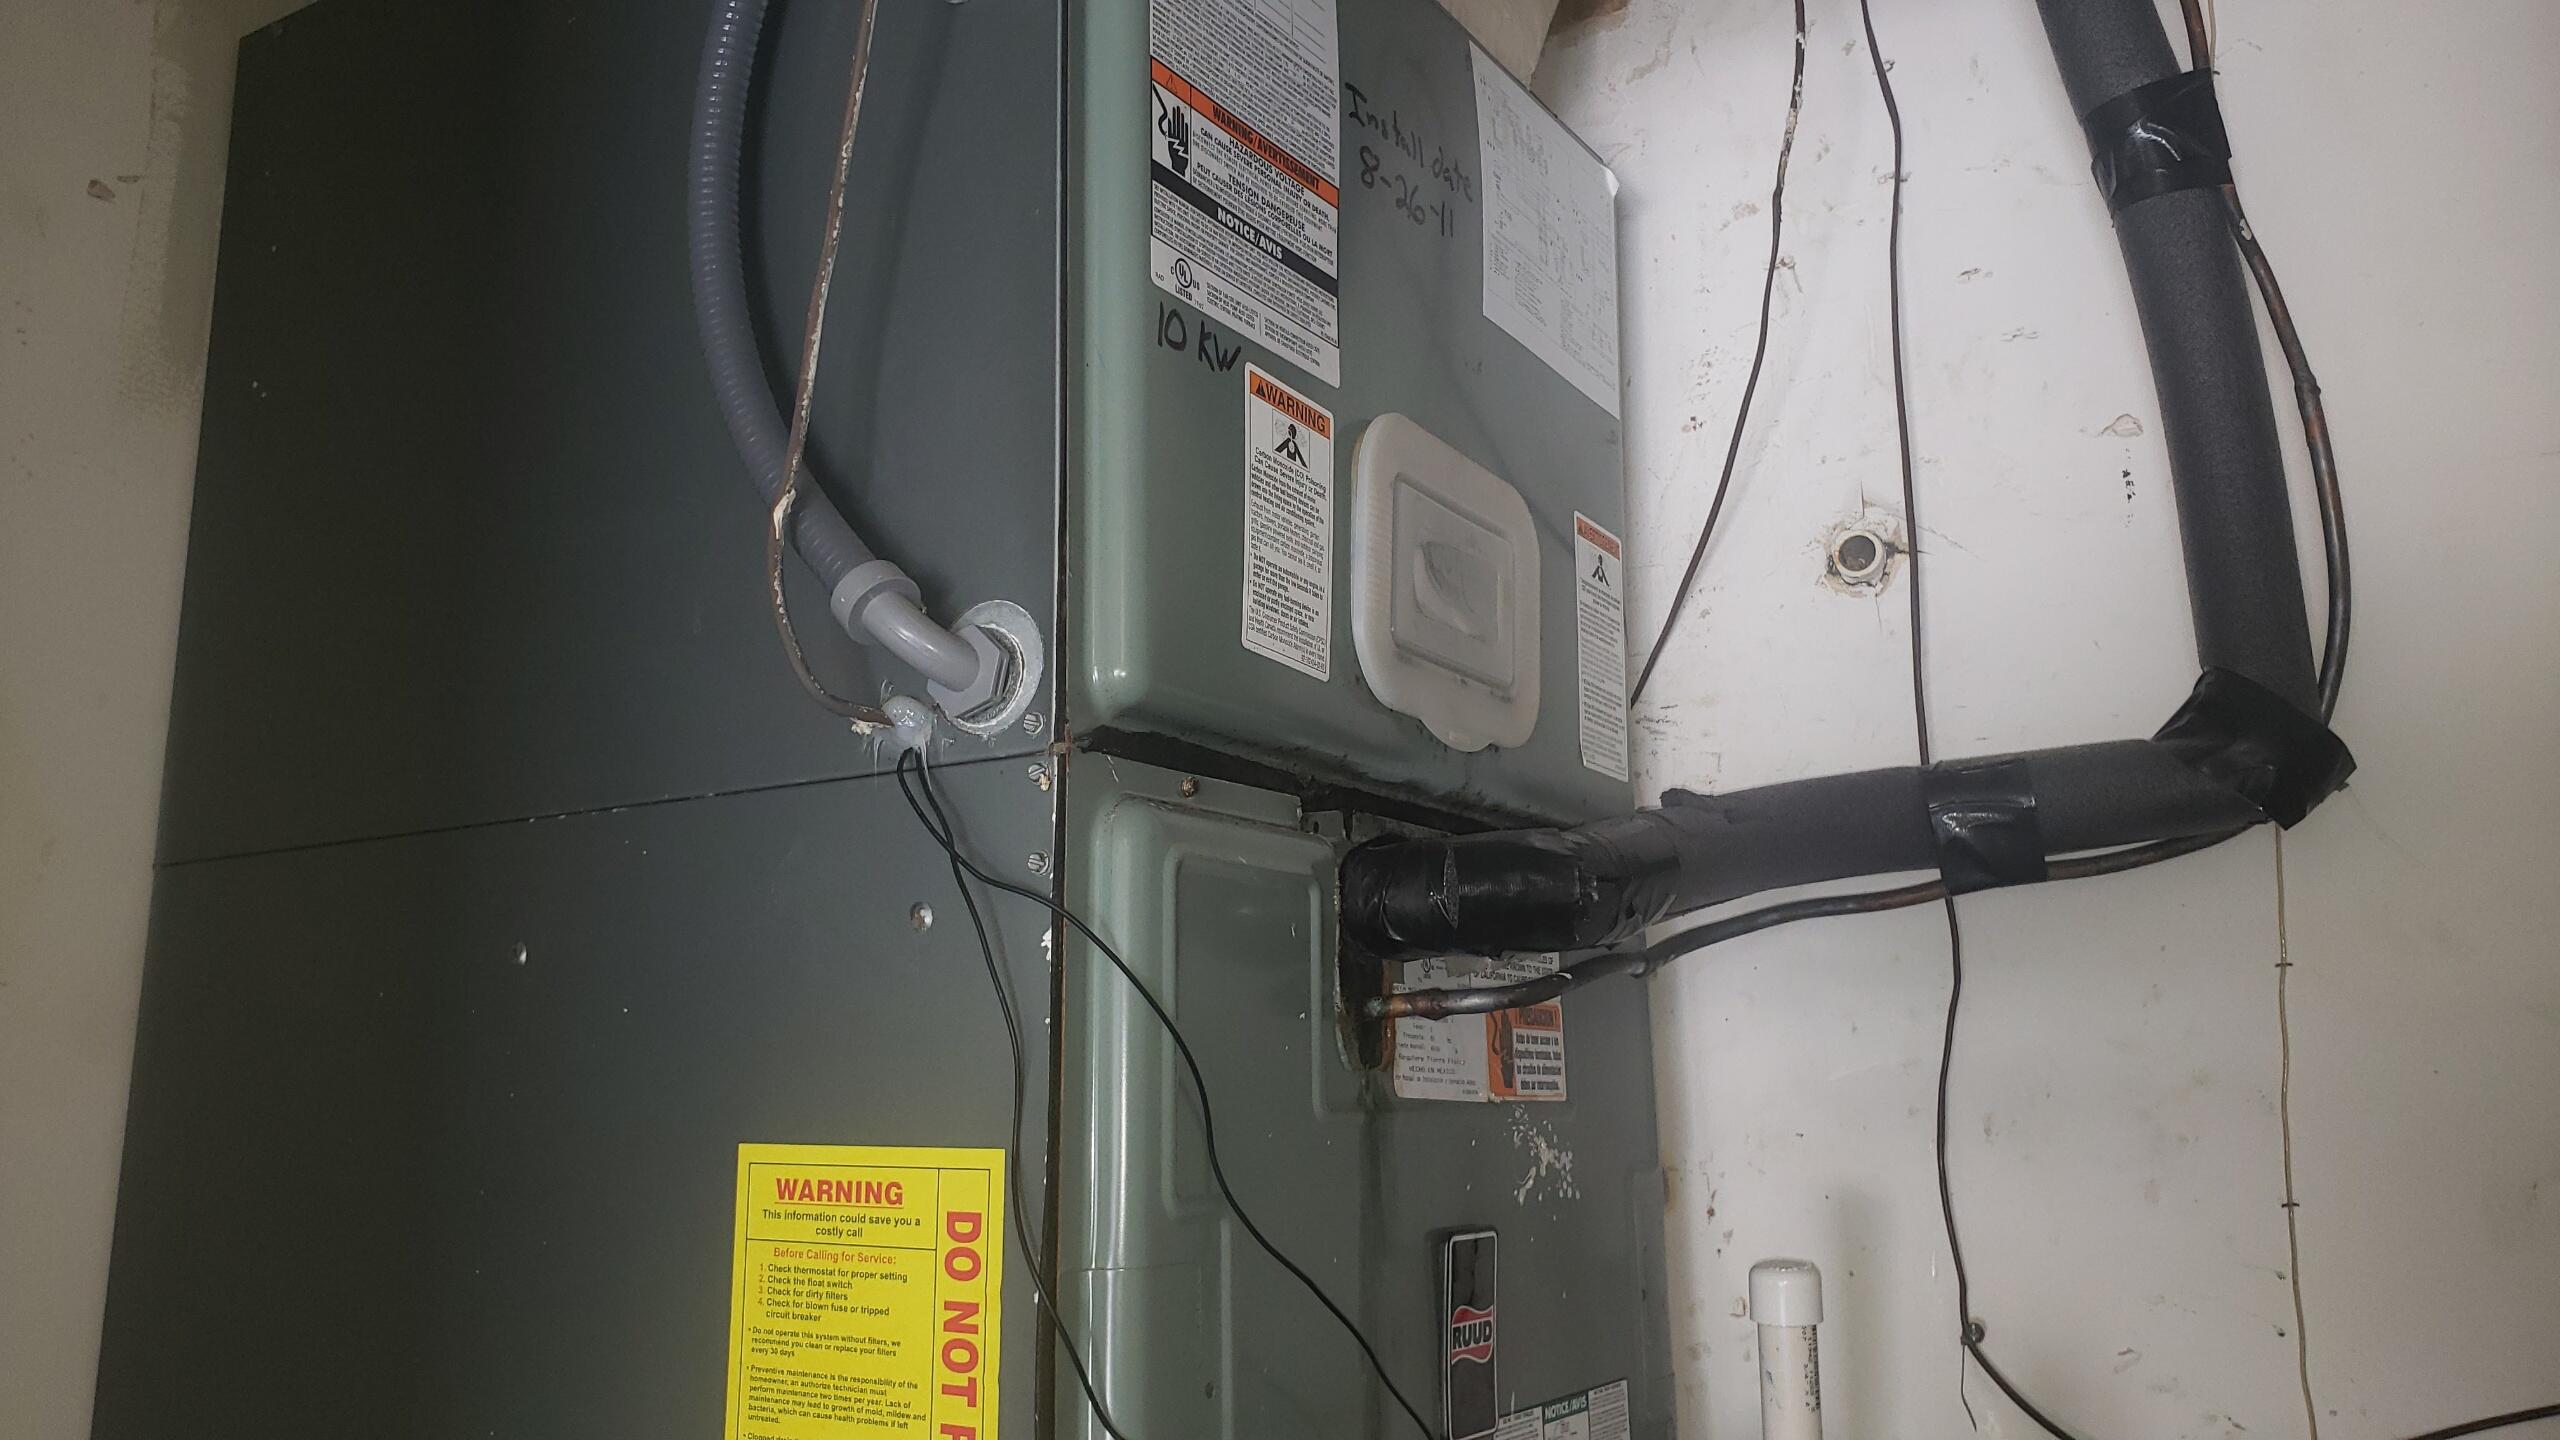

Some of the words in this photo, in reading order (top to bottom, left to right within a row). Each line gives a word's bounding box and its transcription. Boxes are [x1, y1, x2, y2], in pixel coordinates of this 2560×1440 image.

[1345, 82, 1424, 168] Install
[1431, 145, 1473, 203] date
[1229, 136, 1273, 175] HAZARDOUS
[1274, 167, 1304, 196] VOLTAGE
[1227, 172, 1258, 201] TENSION
[1260, 194, 1305, 232] DANGEREUSE
[1233, 185, 1243, 200] DES
[1359, 145, 1455, 239] 8-26-11
[1217, 205, 1282, 261] NOTICE/AVIS
[1174, 283, 1192, 302] LISTED
[1157, 301, 1187, 351] 10
[1265, 383, 1325, 433] WARNING
[1254, 454, 1263, 466] Can
[1264, 459, 1278, 474] Cause
[1279, 467, 1294, 483] Severe
[1294, 477, 1307, 492] Injury
[1307, 484, 1313, 493] or
[1255, 445, 1272, 462] Carbon
[1272, 455, 1294, 474] Monoxide
[1294, 467, 1304, 482] (CO)
[1304, 473, 1326, 494] Poisoning
[775, 1177, 903, 1205] WARNING
[762, 1209, 781, 1219] This
[784, 1209, 836, 1222] information
[839, 1211, 865, 1223] could
[868, 1214, 891, 1225] save
[893, 1215, 912, 1228] you
[914, 1216, 920, 1226] a
[814, 1225, 843, 1238] costly
[846, 1226, 863, 1237] call
[773, 1247, 803, 1259] Before
[805, 1248, 839, 1263] Calling
[841, 1250, 854, 1262] for
[856, 1251, 896, 1264] Service:
[945, 1210, 982, 1282] DO
[767, 1263, 791, 1273] Check
[793, 1264, 835, 1276] thermostat
[838, 1267, 849, 1277] for
[851, 1269, 877, 1281] proper
[879, 1270, 907, 1283] setting
[767, 1275, 790, 1285] Check
[792, 1276, 805, 1286] the
[806, 1277, 825, 1287] float
[826, 1278, 852, 1290] switch
[767, 1286, 790, 1296] Check
[792, 1288, 803, 1297] for
[805, 1288, 823, 1301] dirty
[825, 1290, 848, 1301] filters
[765, 1309, 790, 1319] circuit
[791, 1311, 821, 1322] breaker
[766, 1297, 790, 1308] Check
[792, 1299, 803, 1309] for
[805, 1300, 829, 1311] blown
[830, 1302, 847, 1312] fuse
[850, 1305, 858, 1313] or
[860, 1305, 889, 1317] tripped
[751, 1336, 789, 1347] recommend
[790, 1340, 803, 1350] you
[804, 1341, 822, 1350] clean
[832, 1343, 857, 1355] replace
[859, 1347, 875, 1356] your
[876, 1347, 896, 1357] filters
[752, 1326, 762, 1334] Do
[762, 1327, 774, 1335] not
[775, 1329, 799, 1339] operate
[801, 1330, 813, 1339] this
[814, 1332, 839, 1343] system
[840, 1334, 866, 1344] without
[1452, 1319, 1493, 1351] RUUD
[751, 1346, 768, 1356] every
[779, 1348, 794, 1359] days
[942, 1300, 980, 1408] NOT
[750, 1365, 784, 1375] Preventive
[786, 1368, 828, 1380] maintenance
[829, 1373, 835, 1381] is
[837, 1374, 848, 1382] the
[849, 1375, 896, 1389] responsibility
[898, 1380, 905, 1388] of
[906, 1381, 918, 1389] the
[799, 1379, 831, 1390] authorize
[832, 1383, 867, 1394] technician
[869, 1387, 887, 1396] must
[748, 1394, 789, 1405] maintenance
[791, 1399, 805, 1409] may
[806, 1400, 821, 1409] lead
[822, 1402, 830, 1410] to
[831, 1403, 854, 1415] growth
[856, 1406, 863, 1414] of
[885, 1409, 911, 1419] mildew
[912, 1412, 926, 1421] and
[749, 1384, 774, 1395] perform
[776, 1387, 818, 1399] maintenance
[819, 1392, 832, 1400] two
[833, 1393, 852, 1402] times
[853, 1396, 865, 1405] per
[884, 1399, 901, 1408] Lack
[903, 1401, 910, 1409] of
[777, 1407, 796, 1416] which
[798, 1410, 810, 1418] can
[812, 1411, 832, 1420] cause
[833, 1413, 854, 1423] health
[856, 1416, 888, 1428] problems
[890, 1420, 895, 1428] if
[896, 1420, 908, 1429] left
